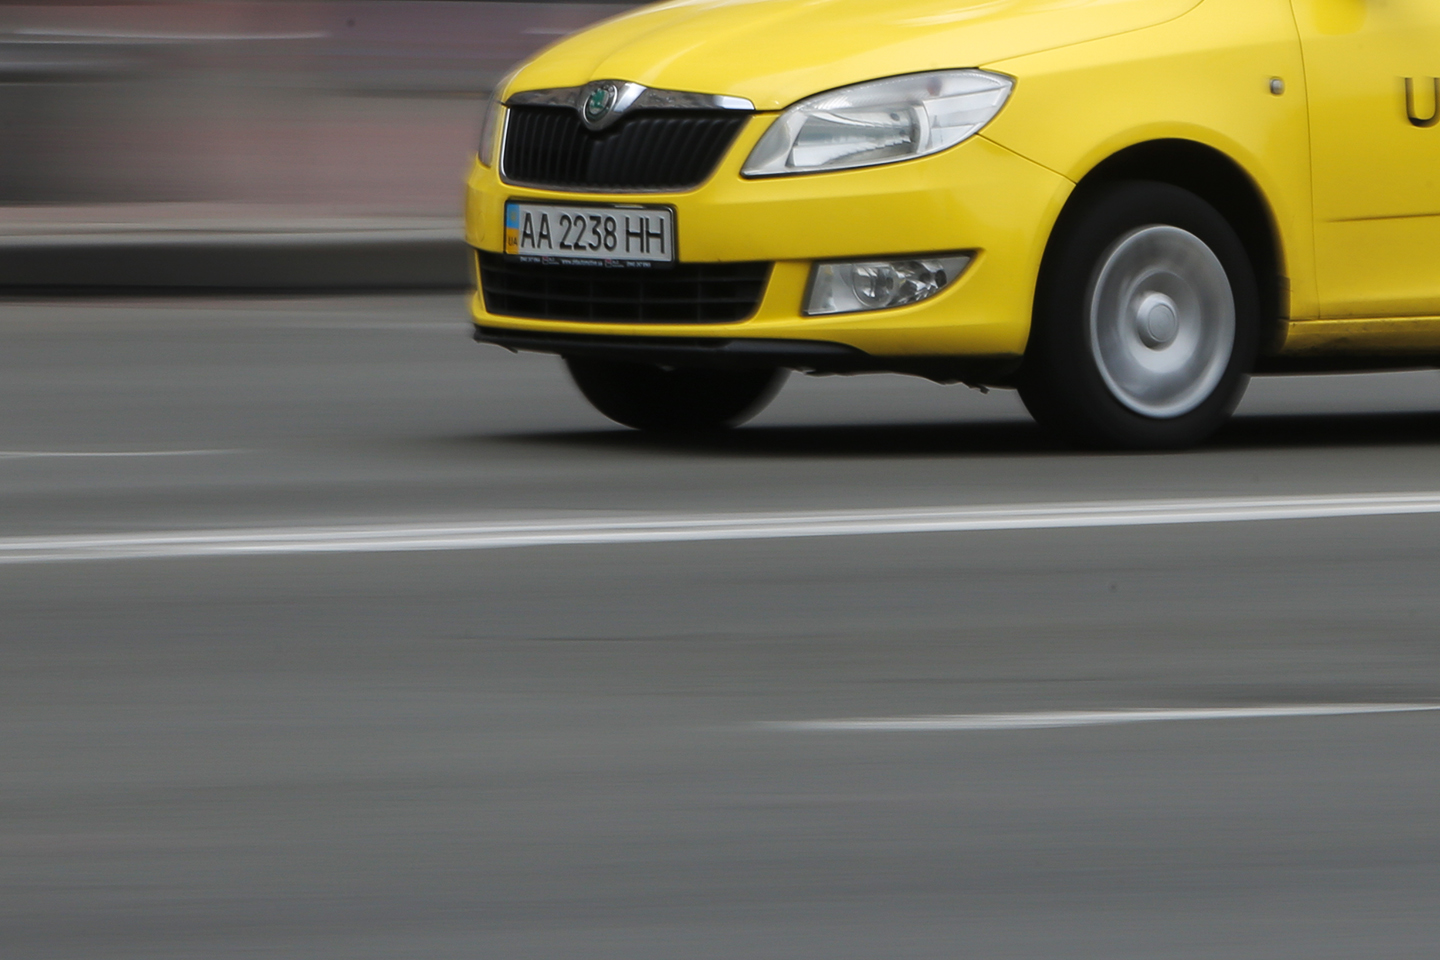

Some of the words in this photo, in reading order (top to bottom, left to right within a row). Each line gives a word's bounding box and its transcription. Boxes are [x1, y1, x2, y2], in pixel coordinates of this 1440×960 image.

[521, 212, 552, 249] AA
[559, 214, 617, 251] 2238
[625, 216, 665, 254] HH
